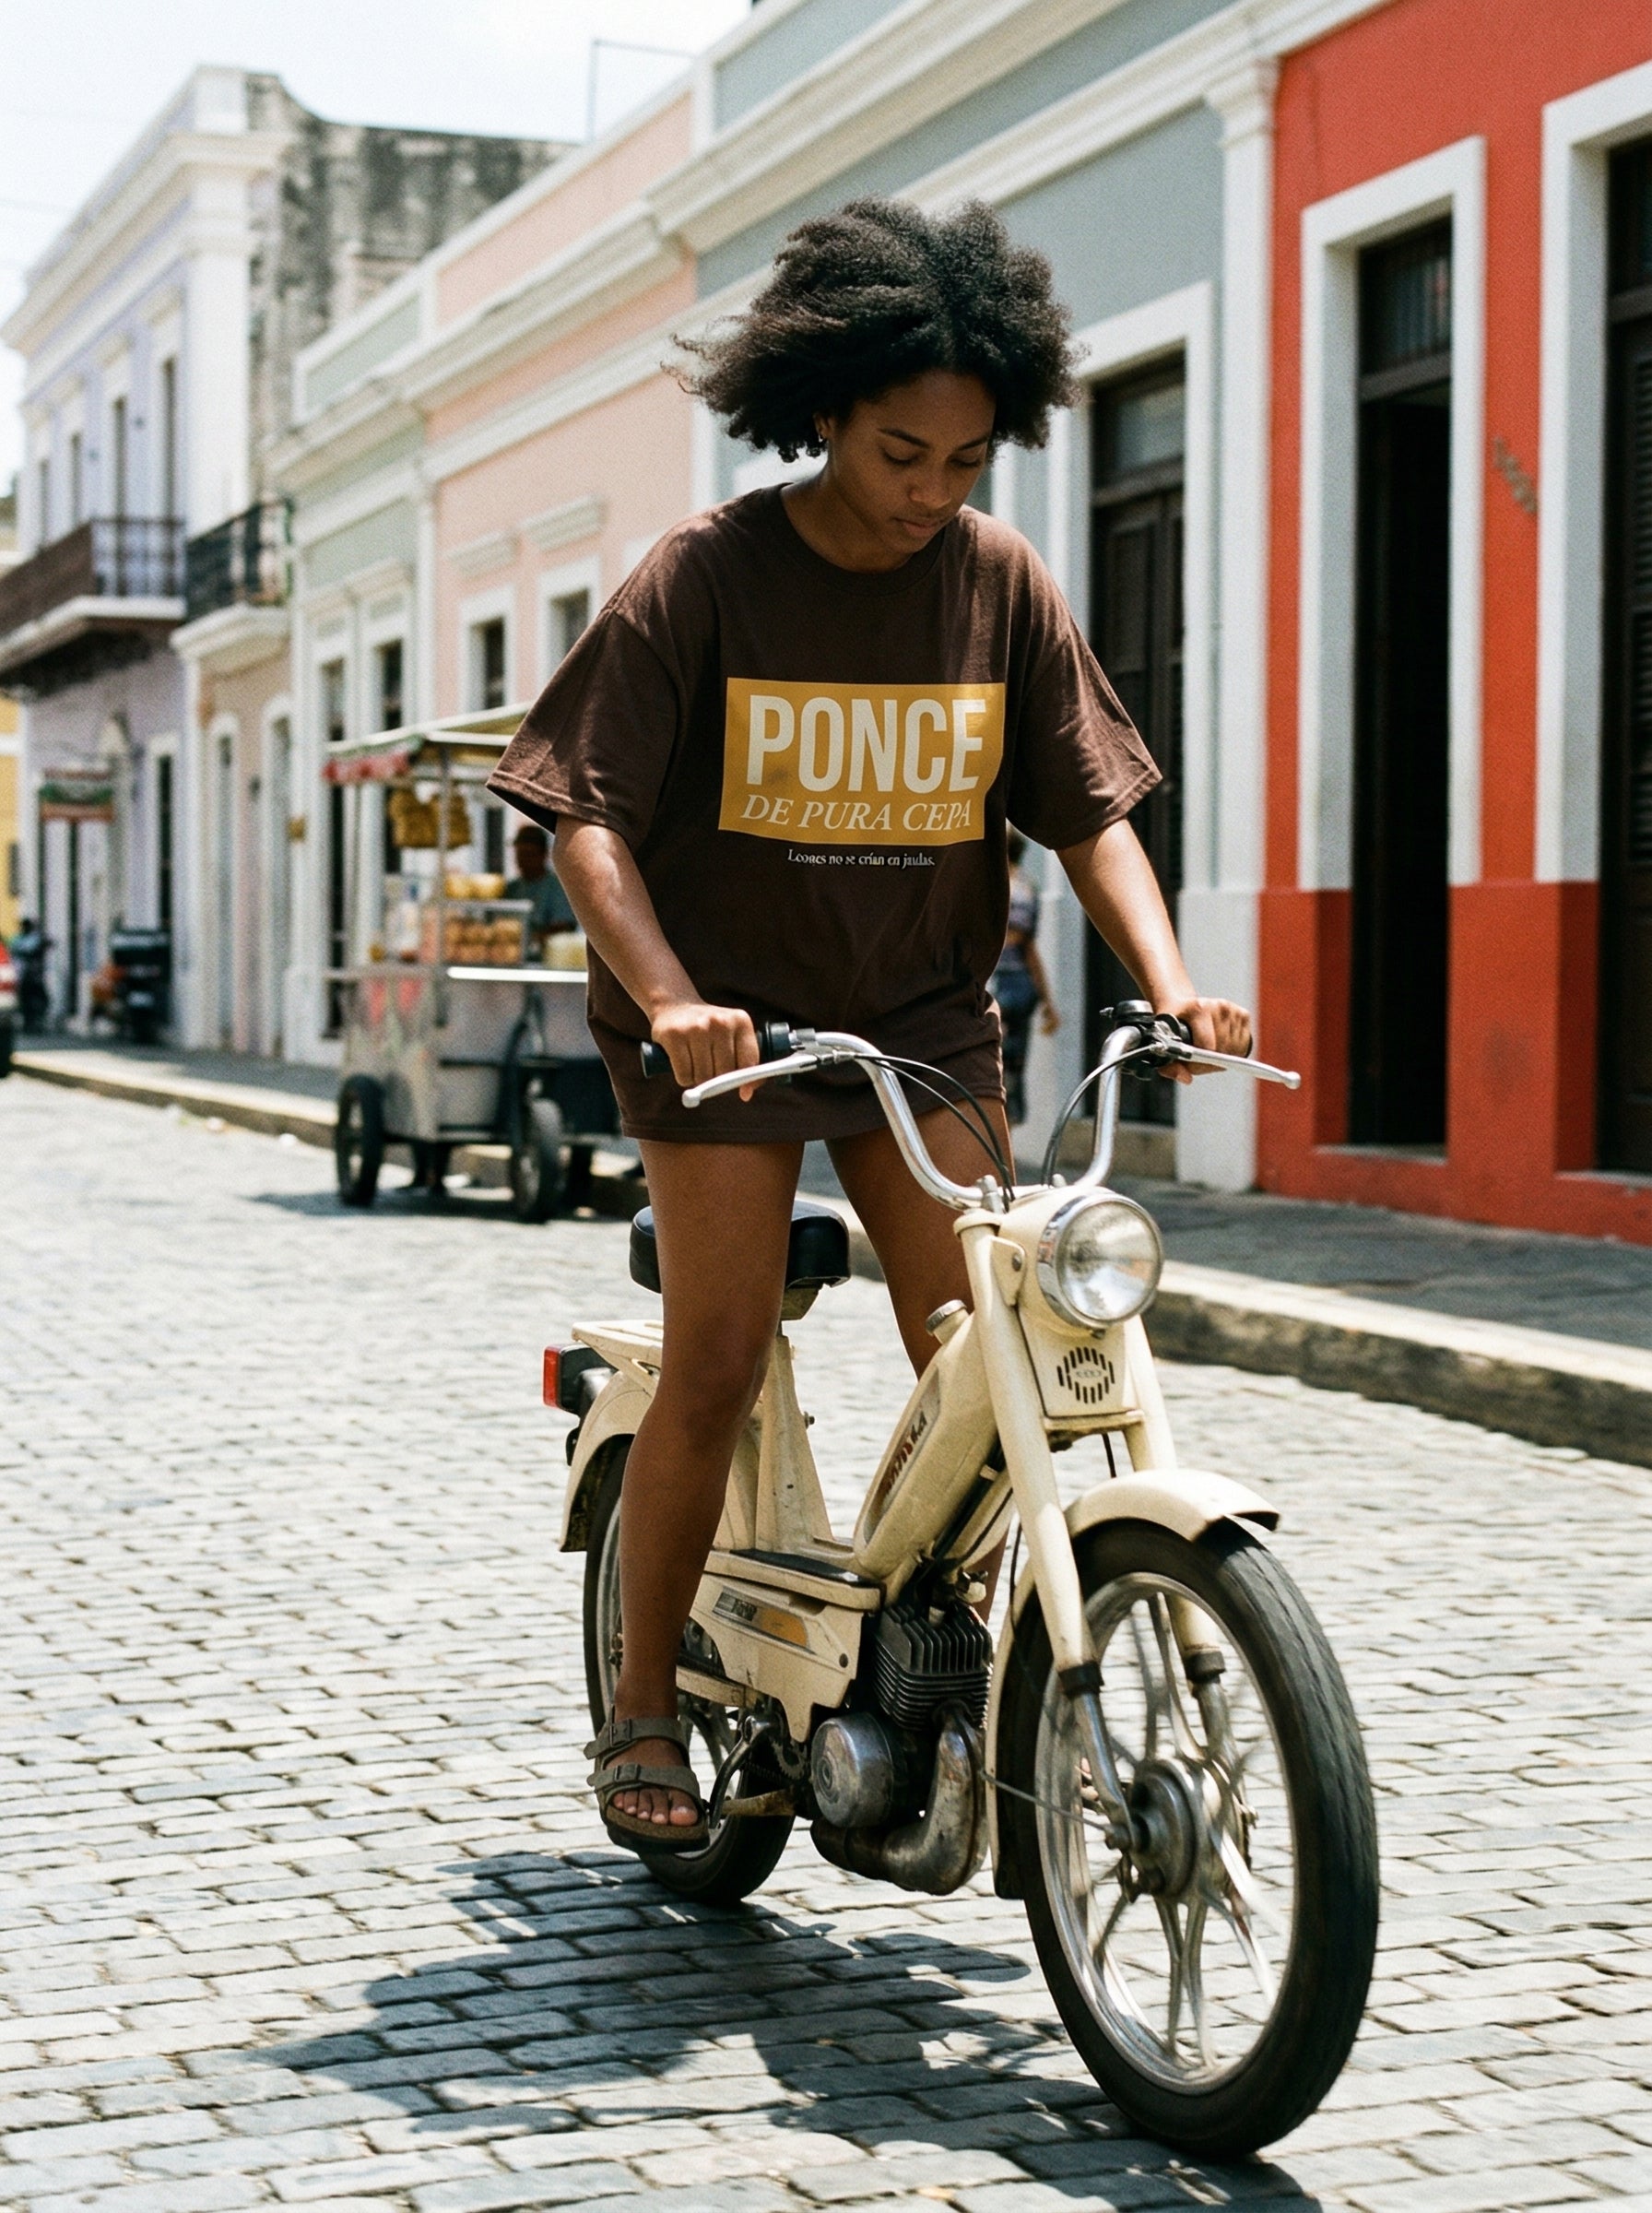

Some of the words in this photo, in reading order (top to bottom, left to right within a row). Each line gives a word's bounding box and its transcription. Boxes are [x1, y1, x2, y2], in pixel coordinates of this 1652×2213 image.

[747, 694, 986, 794] PONCE
[741, 795, 794, 825] DE
[797, 800, 892, 831] PURA
[903, 799, 972, 831] CEPA
[829, 855, 844, 866] no
